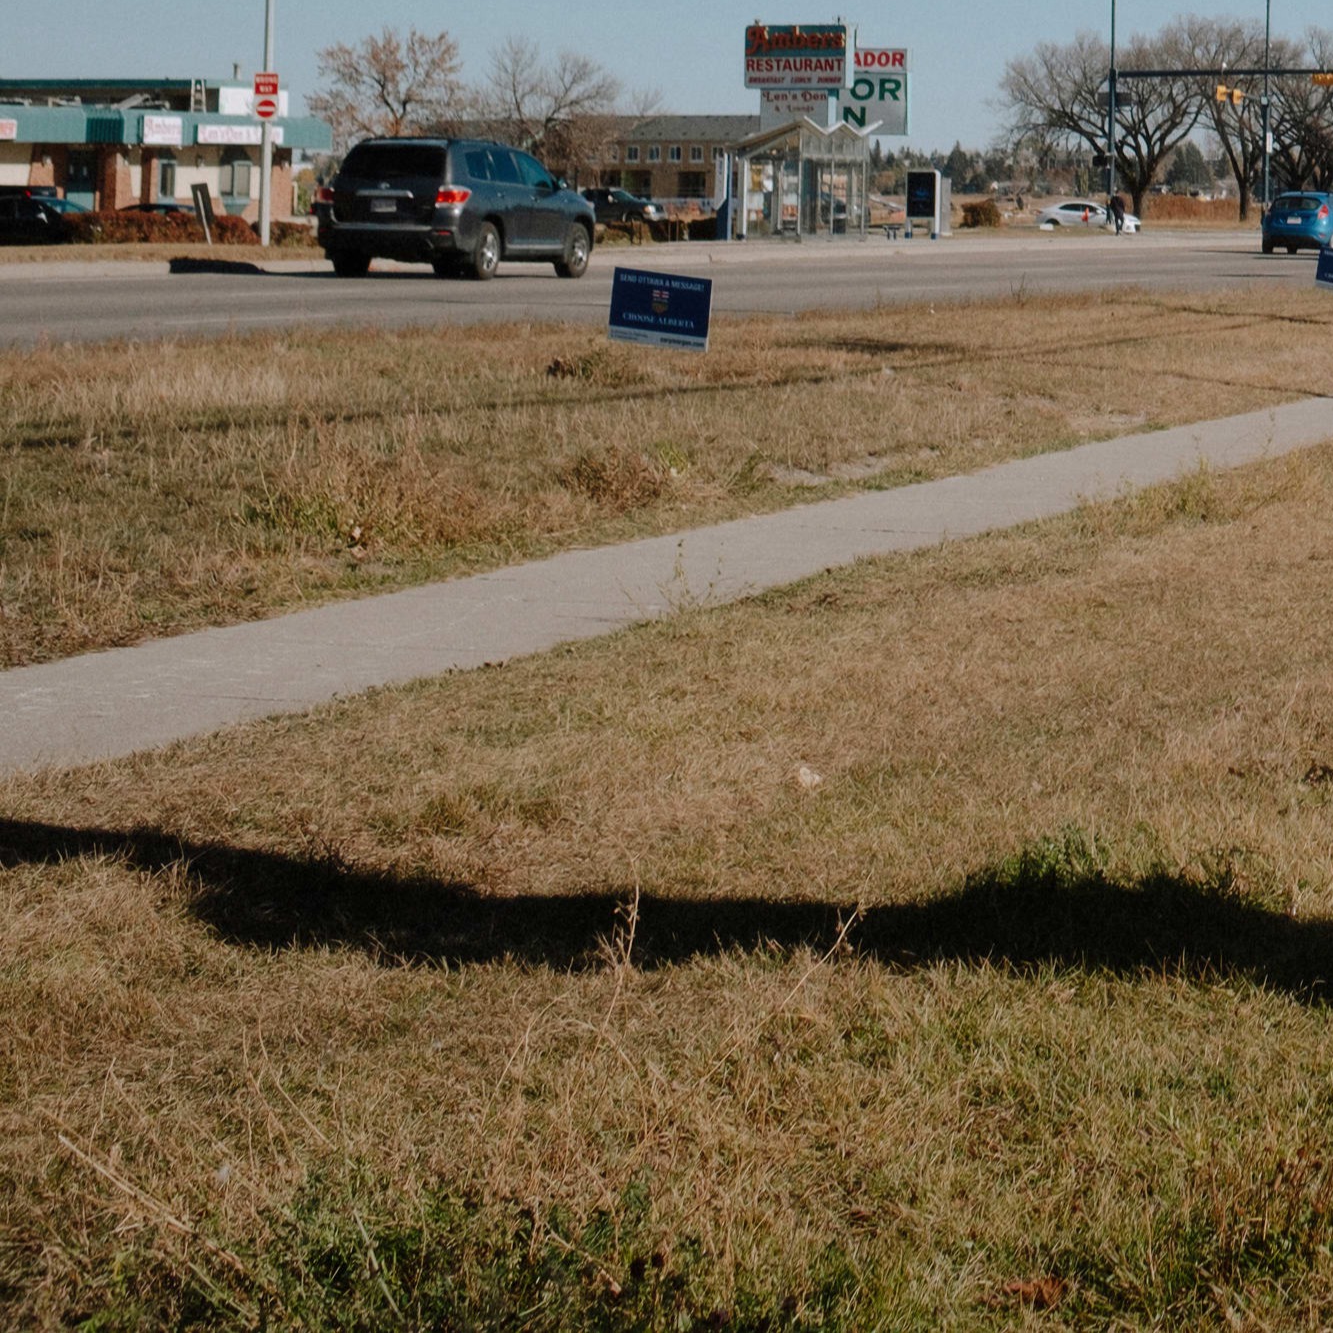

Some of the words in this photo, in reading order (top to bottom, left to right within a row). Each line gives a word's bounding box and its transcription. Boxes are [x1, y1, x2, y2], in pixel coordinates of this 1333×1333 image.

[746, 25, 845, 55] Ambers
[746, 58, 843, 72] RESTAURANT
[837, 78, 902, 101] OR
